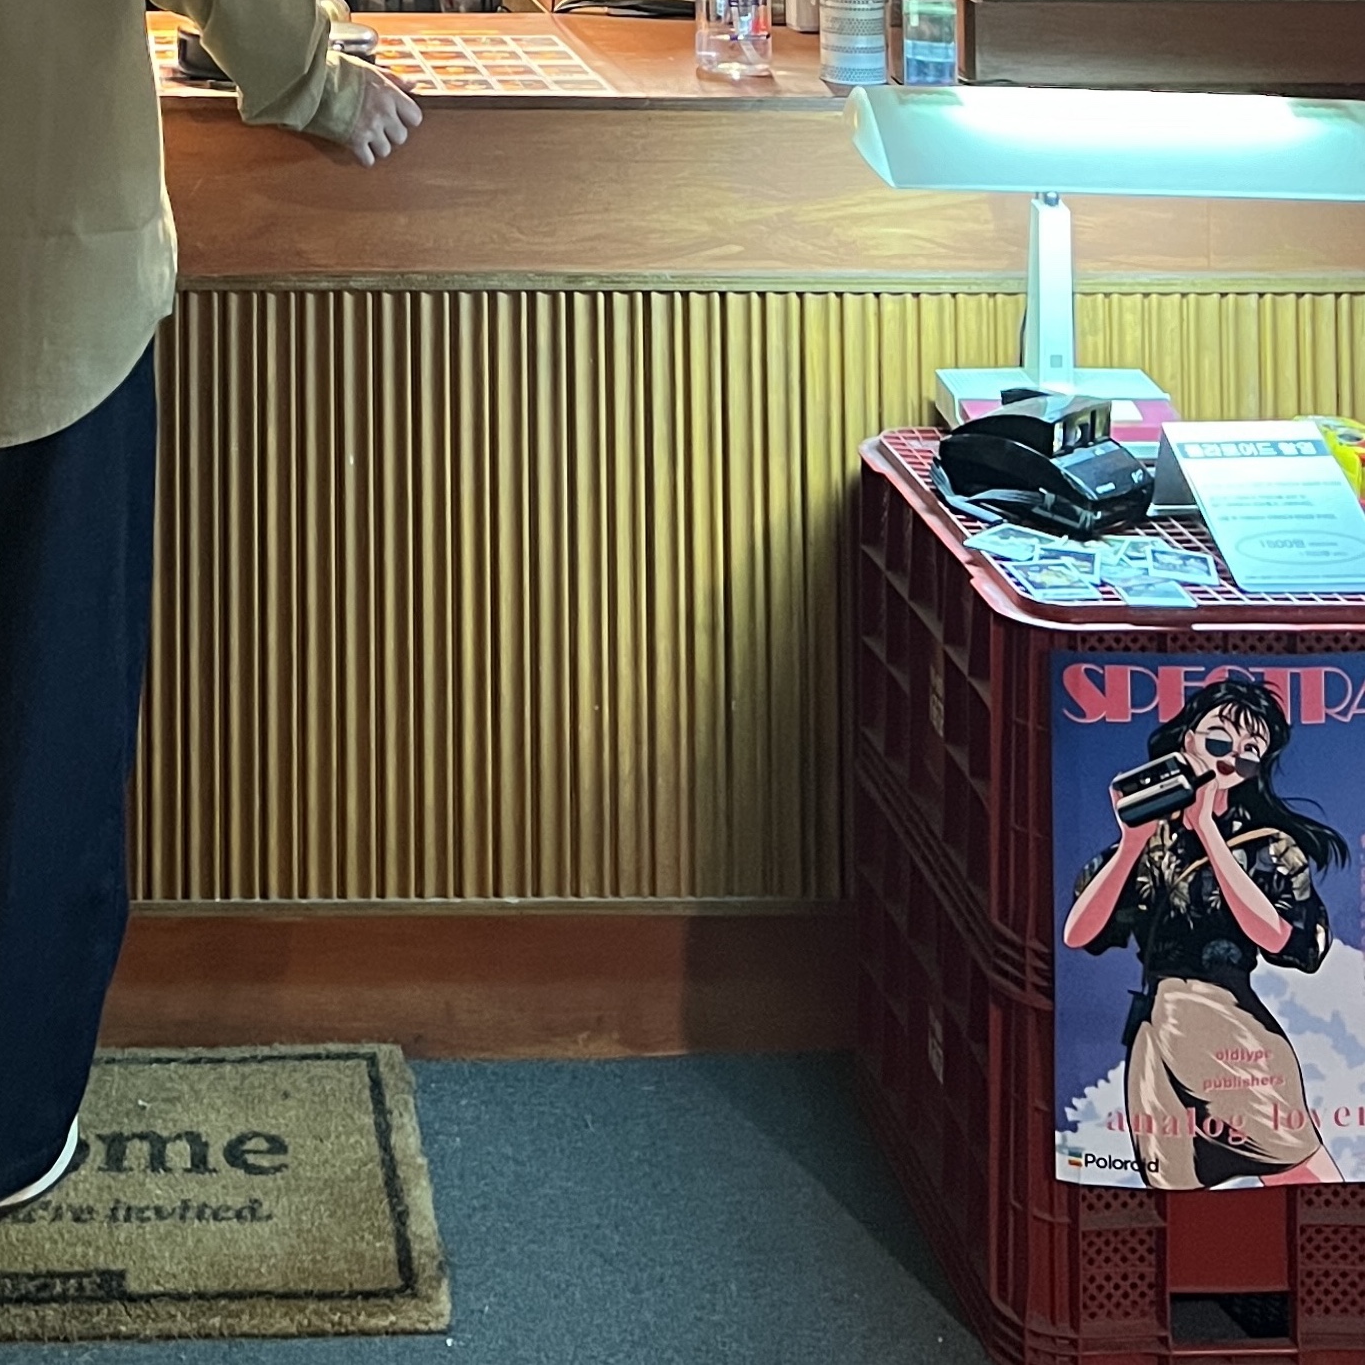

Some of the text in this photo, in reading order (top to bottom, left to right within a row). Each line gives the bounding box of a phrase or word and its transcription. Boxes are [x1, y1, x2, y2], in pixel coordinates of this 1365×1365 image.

[1062, 661, 1365, 725] SPETR
[1202, 1072, 1285, 1092] publishers
[1106, 1105, 1249, 1144] analog
[1083, 1152, 1160, 1174] Polarod
